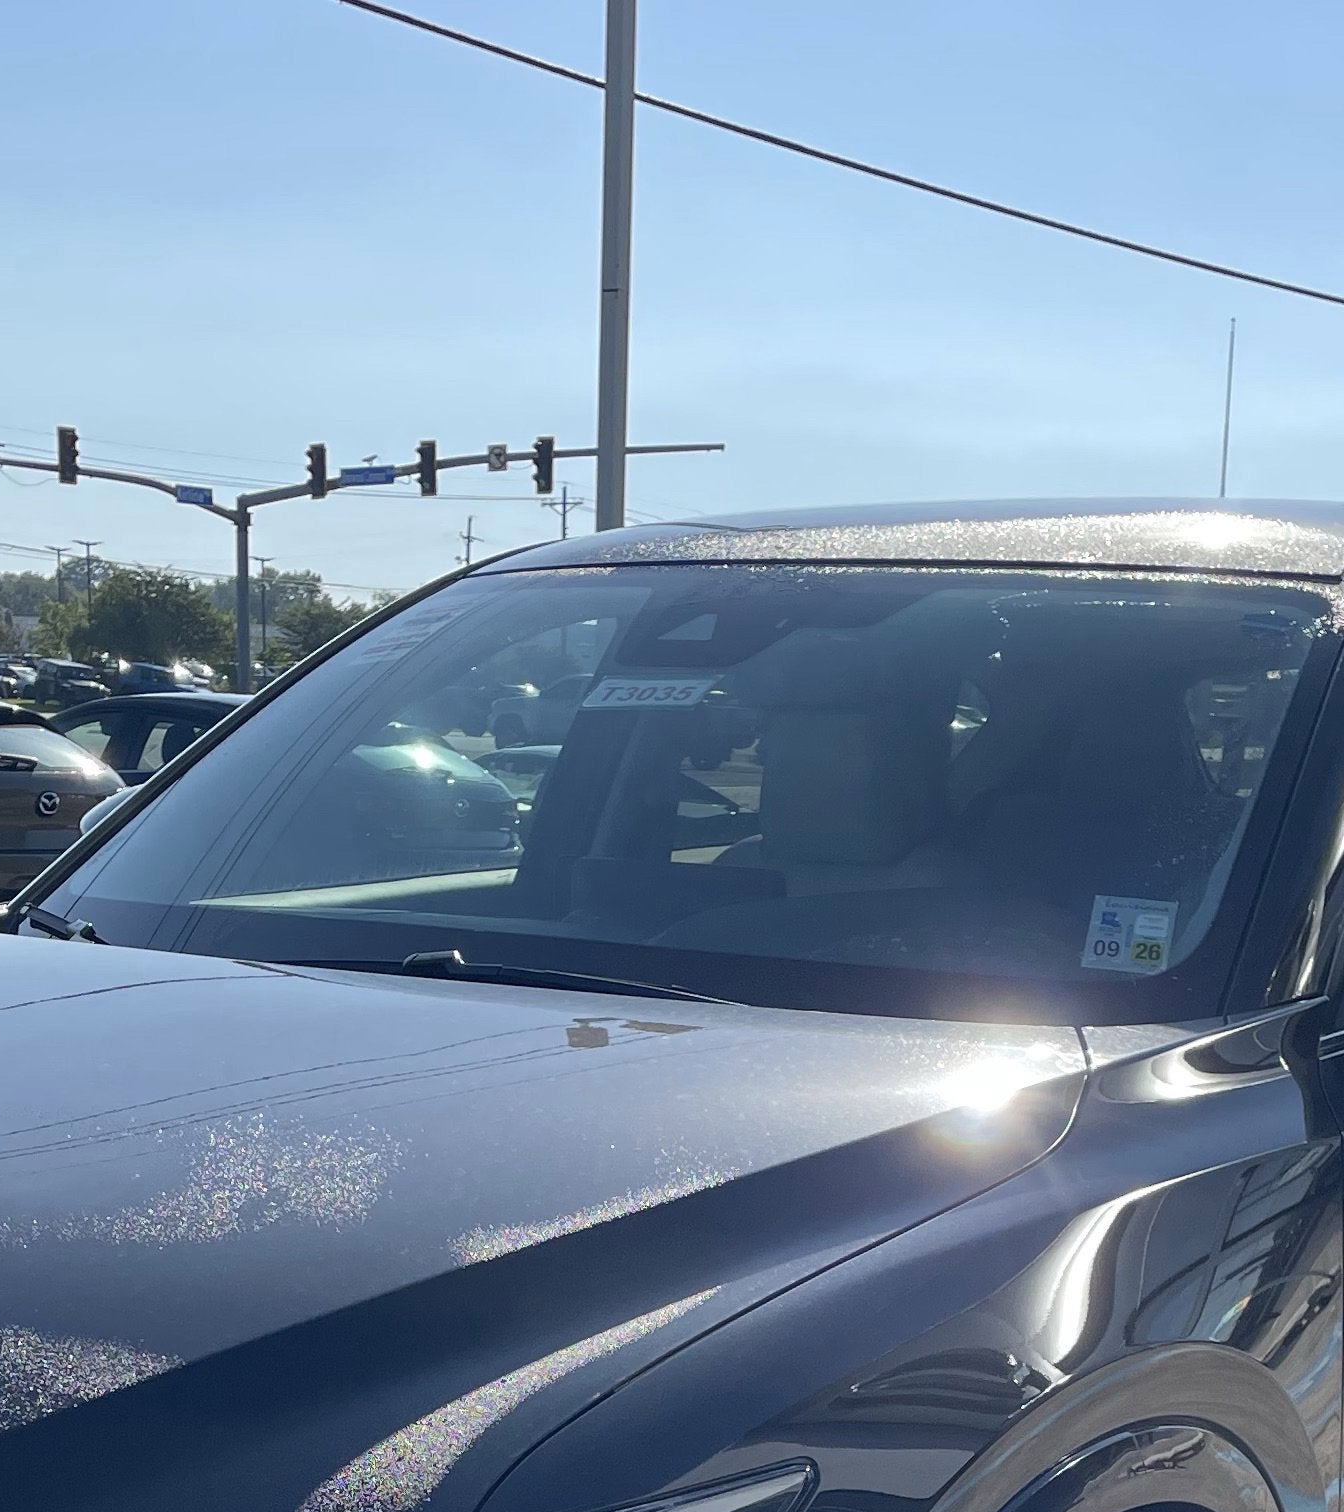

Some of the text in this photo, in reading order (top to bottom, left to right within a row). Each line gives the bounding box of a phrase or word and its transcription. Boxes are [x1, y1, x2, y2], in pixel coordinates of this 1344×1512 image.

[600, 686, 697, 701] T3035
[1093, 939, 1161, 961] 09 26
